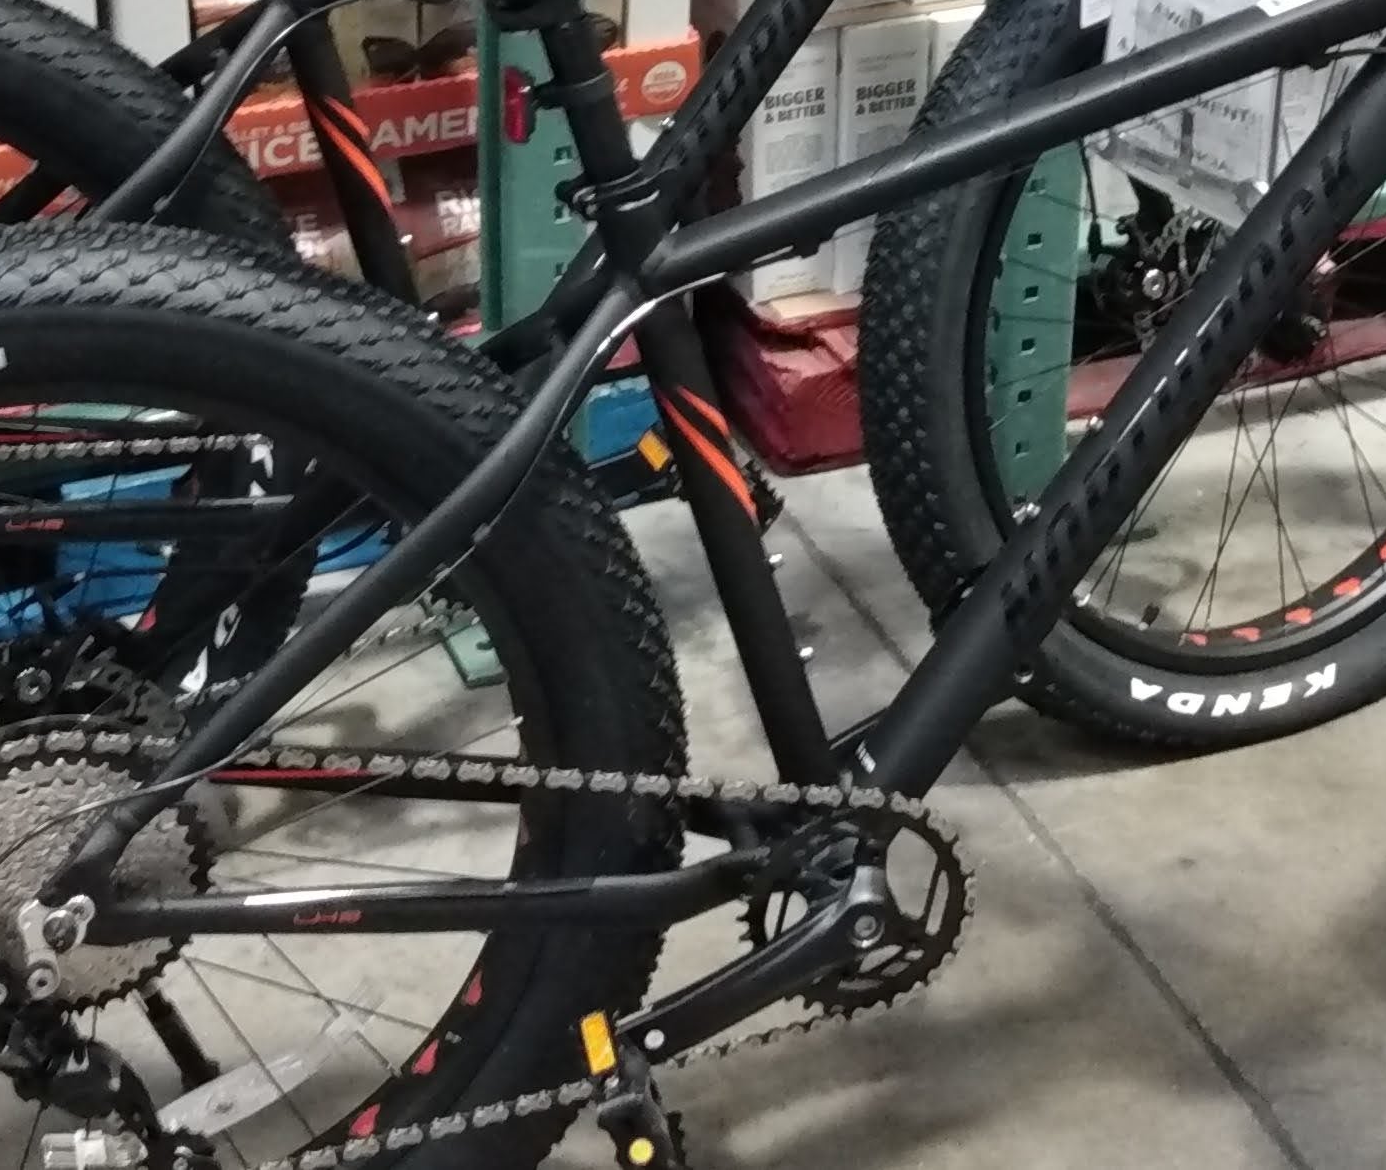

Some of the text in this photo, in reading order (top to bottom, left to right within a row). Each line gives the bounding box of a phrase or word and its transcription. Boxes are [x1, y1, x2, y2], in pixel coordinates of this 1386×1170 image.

[764, 87, 826, 111] BIGGER
[855, 80, 917, 101] BIGGER
[777, 103, 826, 123] BETTER
[869, 97, 917, 115] BETTER
[368, 106, 479, 153] AME
[247, 131, 324, 170] ICE
[1130, 663, 1338, 718] KENDA
